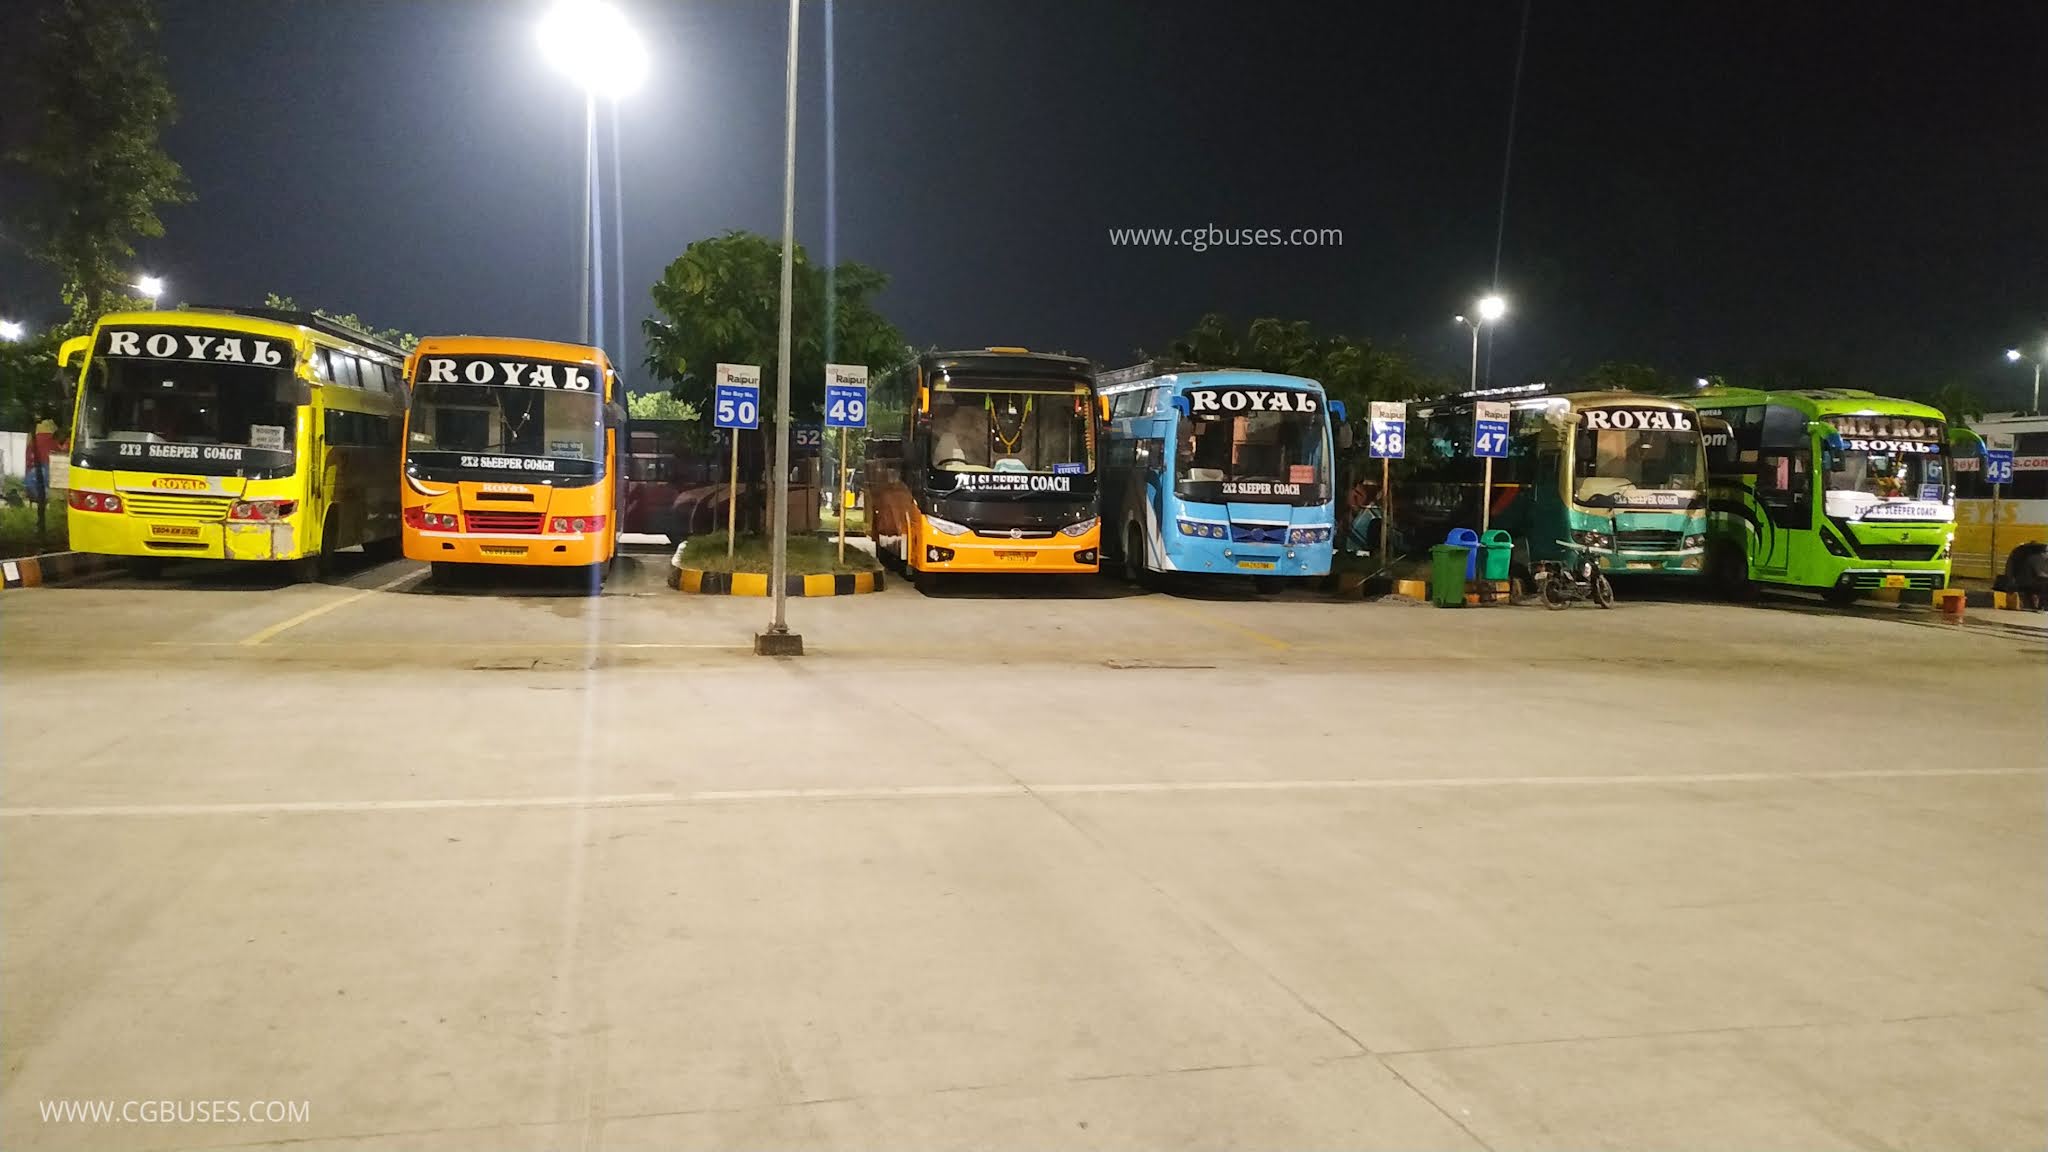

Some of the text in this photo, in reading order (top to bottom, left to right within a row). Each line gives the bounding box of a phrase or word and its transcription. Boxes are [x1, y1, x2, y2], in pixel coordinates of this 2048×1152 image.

[107, 331, 282, 366] ROYAL
[428, 359, 590, 391] ROYAL
[727, 374, 759, 385] Raipur
[836, 374, 867, 385] Raipur
[1191, 390, 1317, 412] ROYAL
[717, 400, 756, 424] 50
[829, 399, 864, 422] 49
[1585, 410, 1692, 431] ROYAL
[796, 429, 820, 445] 52
[1373, 433, 1402, 454] 48
[1477, 432, 1506, 453] 47
[120, 443, 142, 456] 2X2
[149, 444, 199, 459] SLEEPER
[1850, 440, 1931, 453] ROYAL
[460, 456, 479, 467] 2X2
[480, 457, 523, 470] SLEEPER
[1987, 461, 2012, 479] 45
[154, 477, 208, 490] ROYAL
[483, 483, 527, 493] ROYAL
[978, 474, 1029, 491] SLEEPER
[1030, 476, 1070, 492] COACH
[1222, 483, 1300, 495] 2X2 SLEEPER COACH
[1916, 507, 1937, 516] COACH
